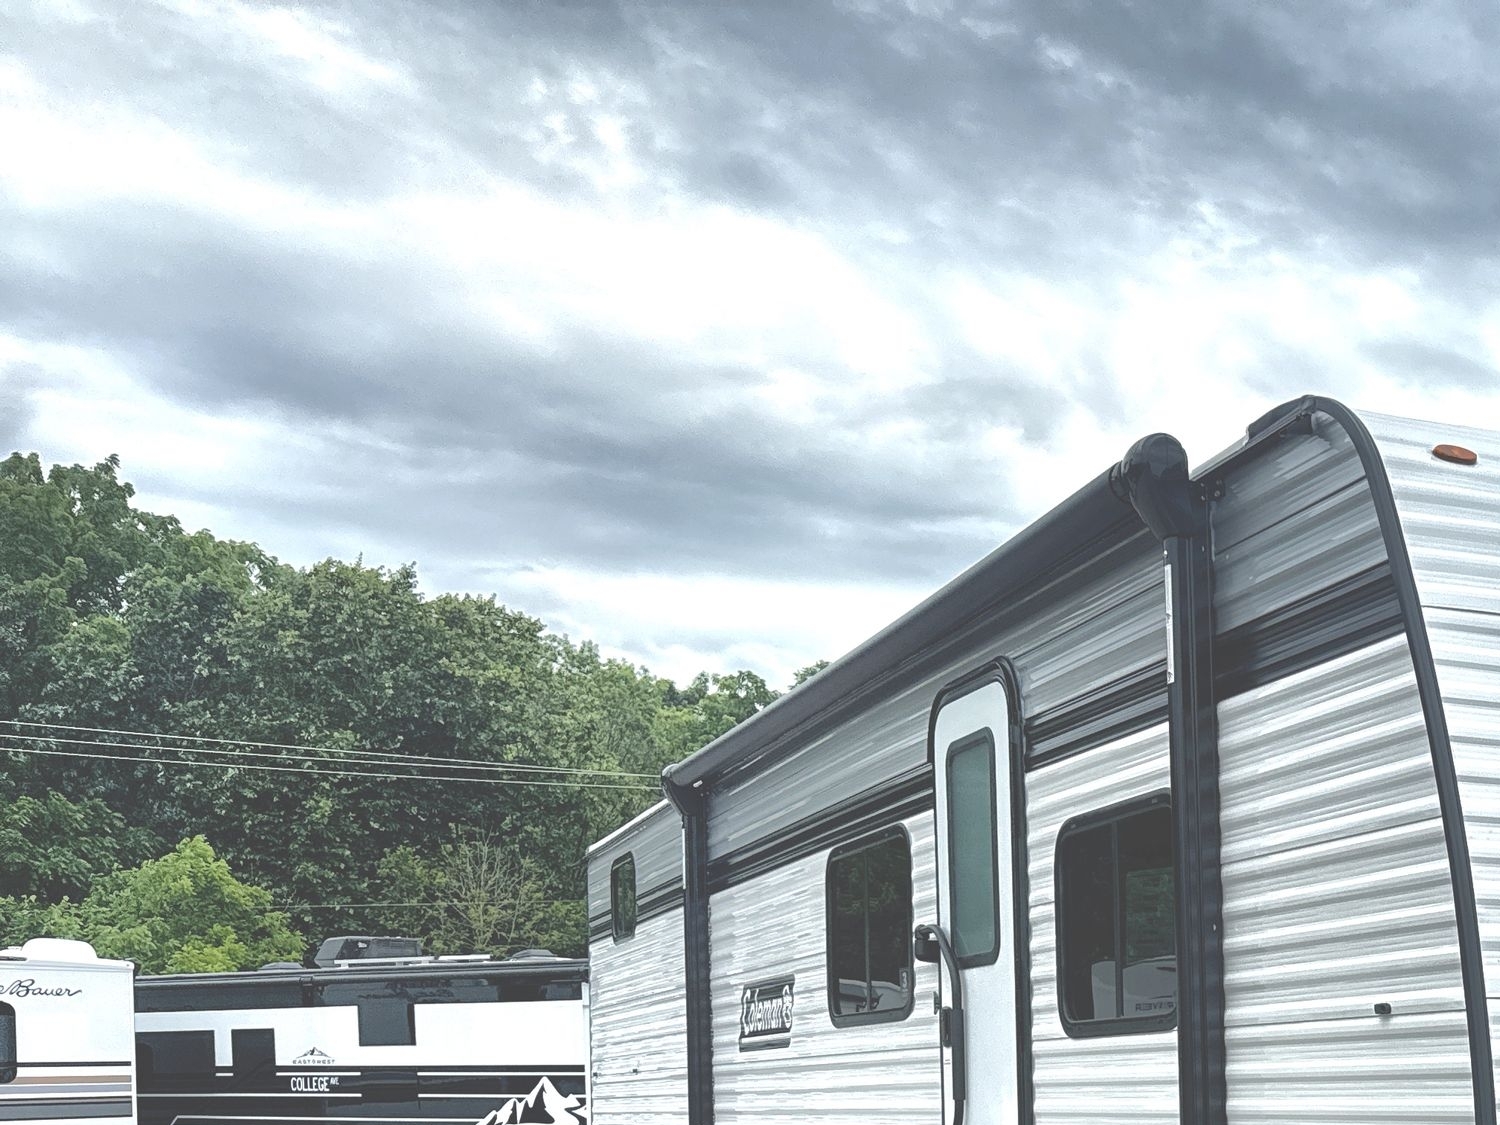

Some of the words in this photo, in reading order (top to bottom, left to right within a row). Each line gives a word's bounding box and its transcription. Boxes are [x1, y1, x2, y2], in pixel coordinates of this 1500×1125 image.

[8, 978, 82, 998] Bauer
[742, 988, 783, 1036] Coleman
[290, 1076, 330, 1092] COLLEGE
